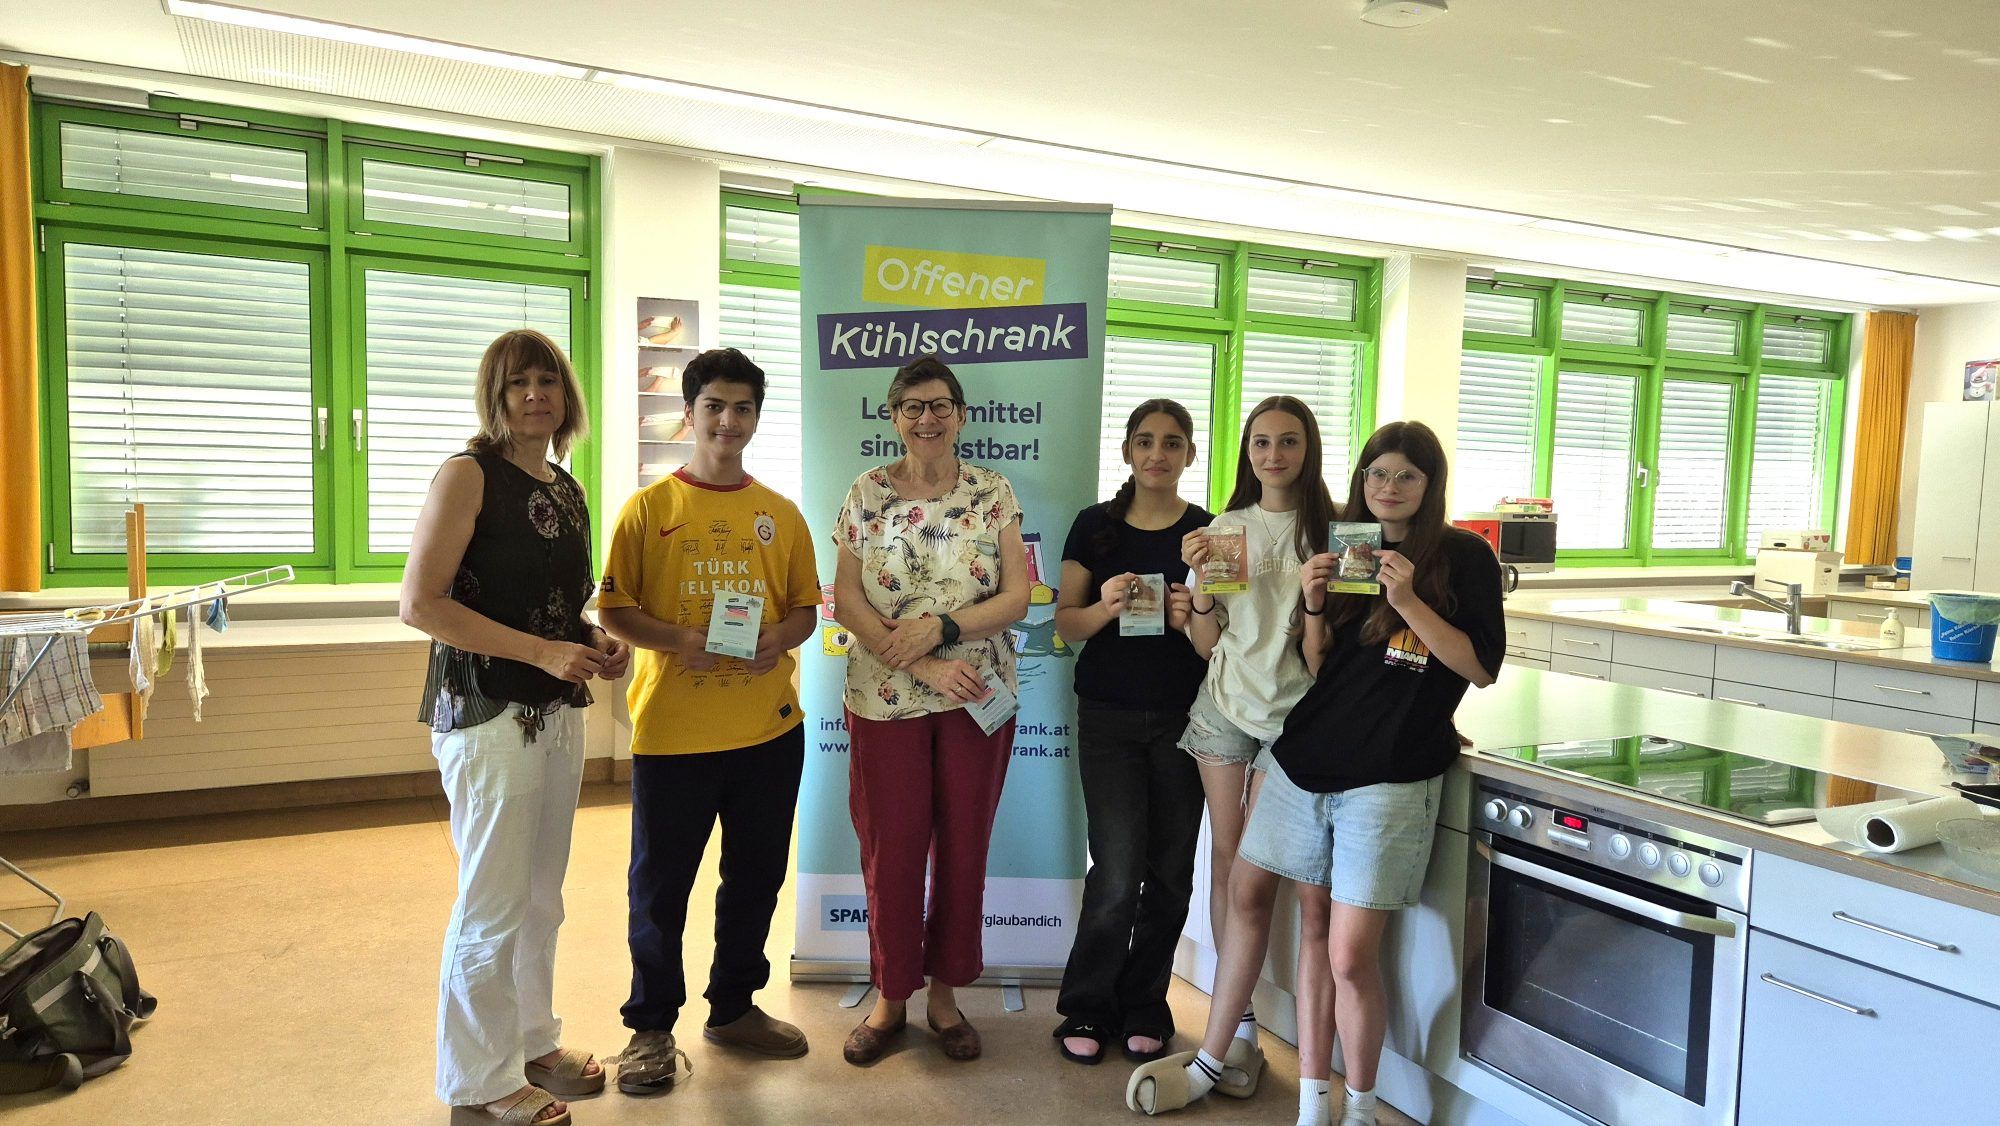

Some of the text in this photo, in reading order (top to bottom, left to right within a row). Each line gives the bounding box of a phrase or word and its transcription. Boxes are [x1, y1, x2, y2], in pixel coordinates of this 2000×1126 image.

[877, 257, 1034, 301] Offener
[830, 313, 1077, 360] Kühlschrank
[692, 557, 750, 576] TÜRK
[1385, 647, 1429, 666] MIAMI
